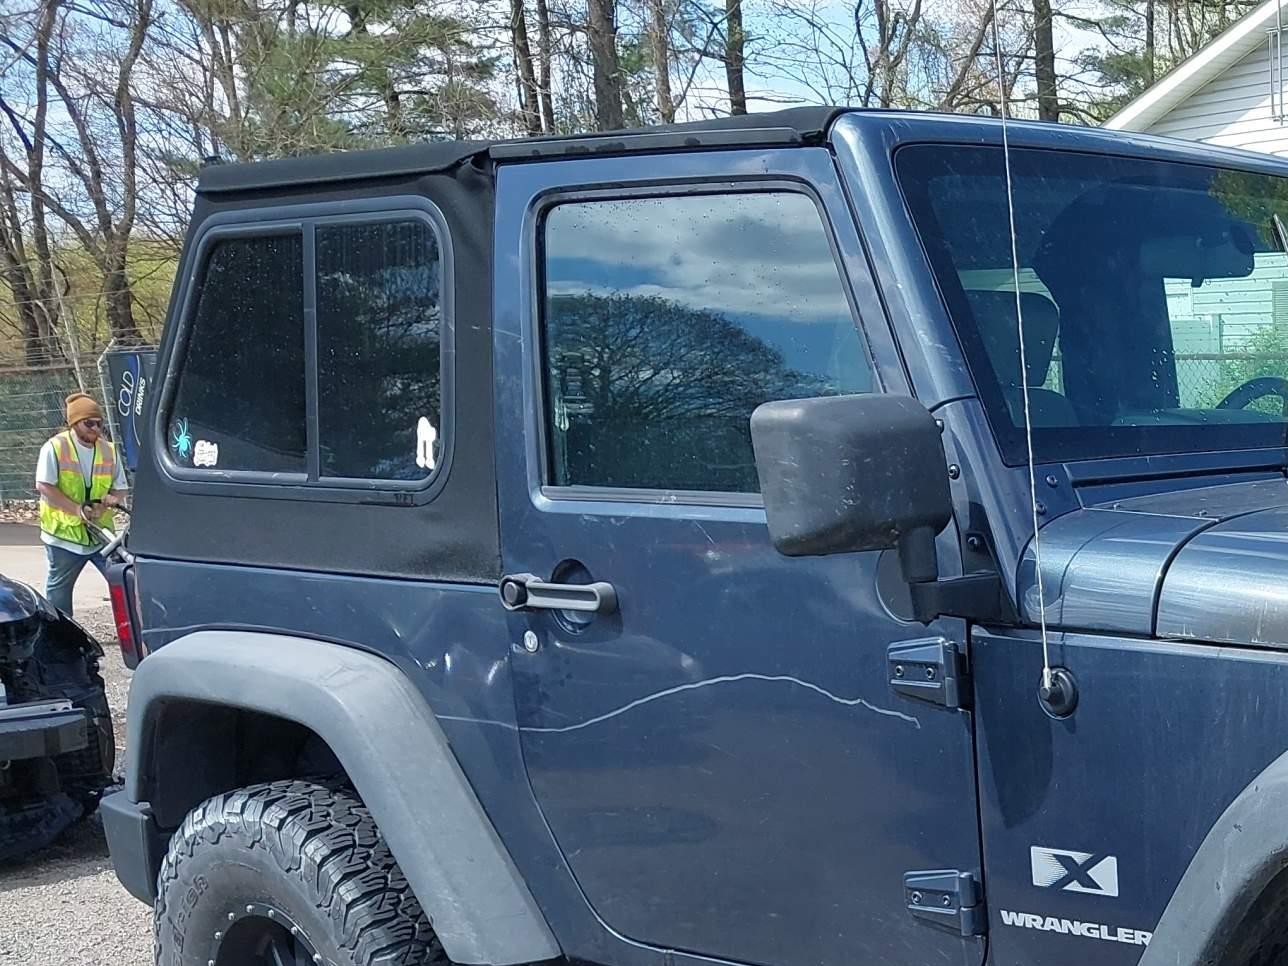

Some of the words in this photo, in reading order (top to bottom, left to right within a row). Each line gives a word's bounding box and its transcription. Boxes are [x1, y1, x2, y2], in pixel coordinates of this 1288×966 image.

[118, 370, 135, 416] COLD
[135, 377, 146, 416] DRINKS
[1000, 909, 1154, 947] WRANGLER
